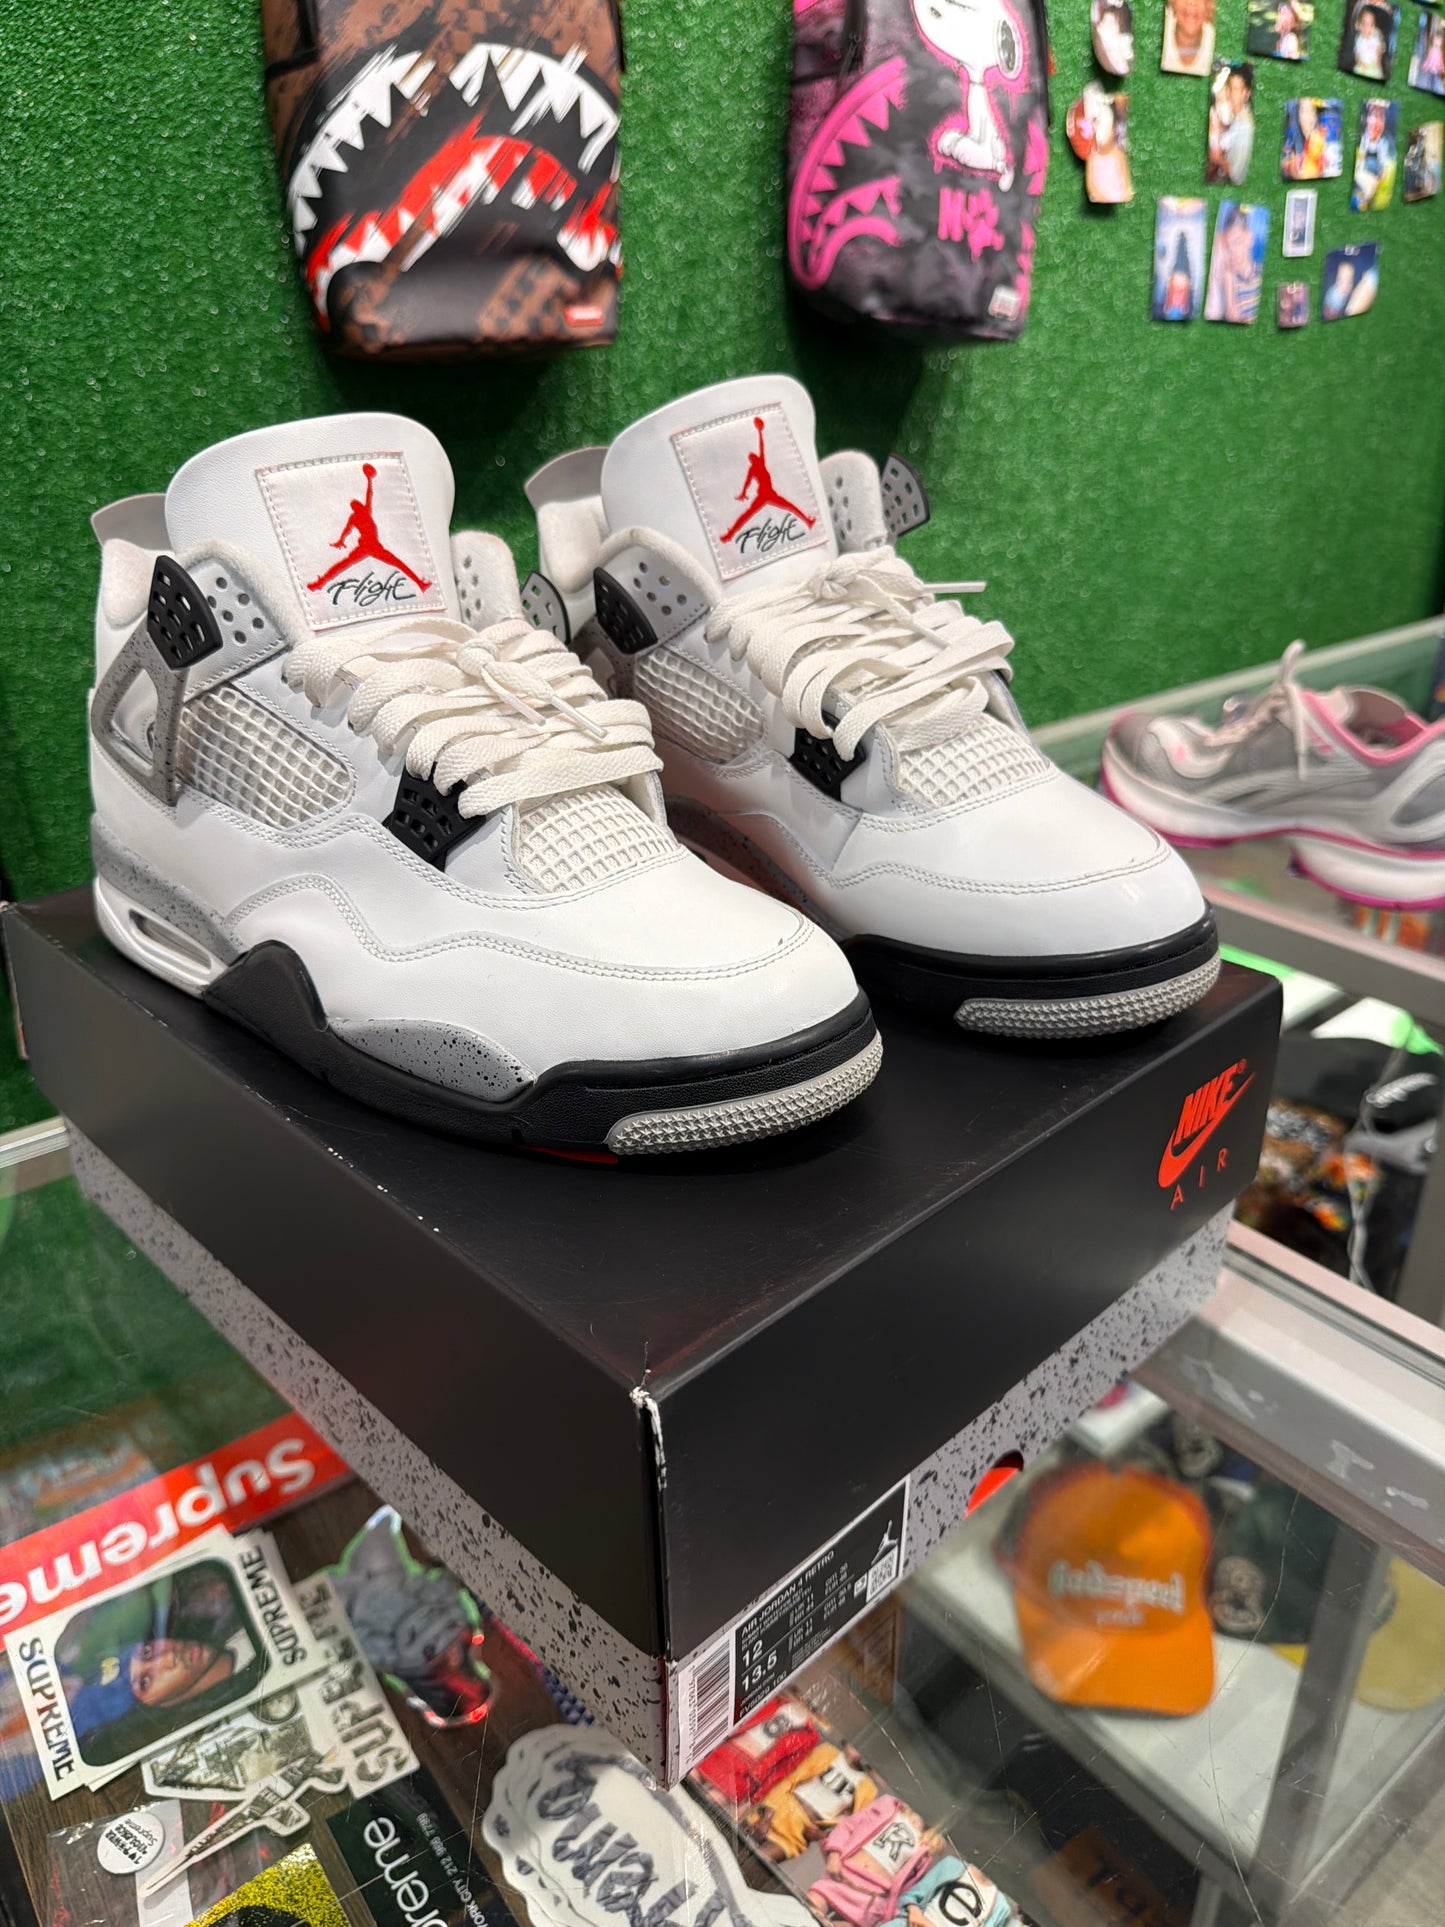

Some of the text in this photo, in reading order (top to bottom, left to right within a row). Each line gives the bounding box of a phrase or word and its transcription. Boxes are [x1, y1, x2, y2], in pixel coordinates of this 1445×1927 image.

[735, 513, 806, 554] Flight
[327, 570, 417, 608] Flight
[1173, 1062, 1239, 1148] NIKE
[1170, 1147, 1229, 1211] AIR
[240, 1545, 307, 1666] SUPREME
[741, 1616, 757, 1637] AIR
[758, 1582, 795, 1622] JORDAN
[805, 1548, 833, 1581] RETRO
[741, 1648, 777, 1694] 13.5
[742, 1637, 762, 1670] 12
[18, 1637, 75, 1782] SUPREME
